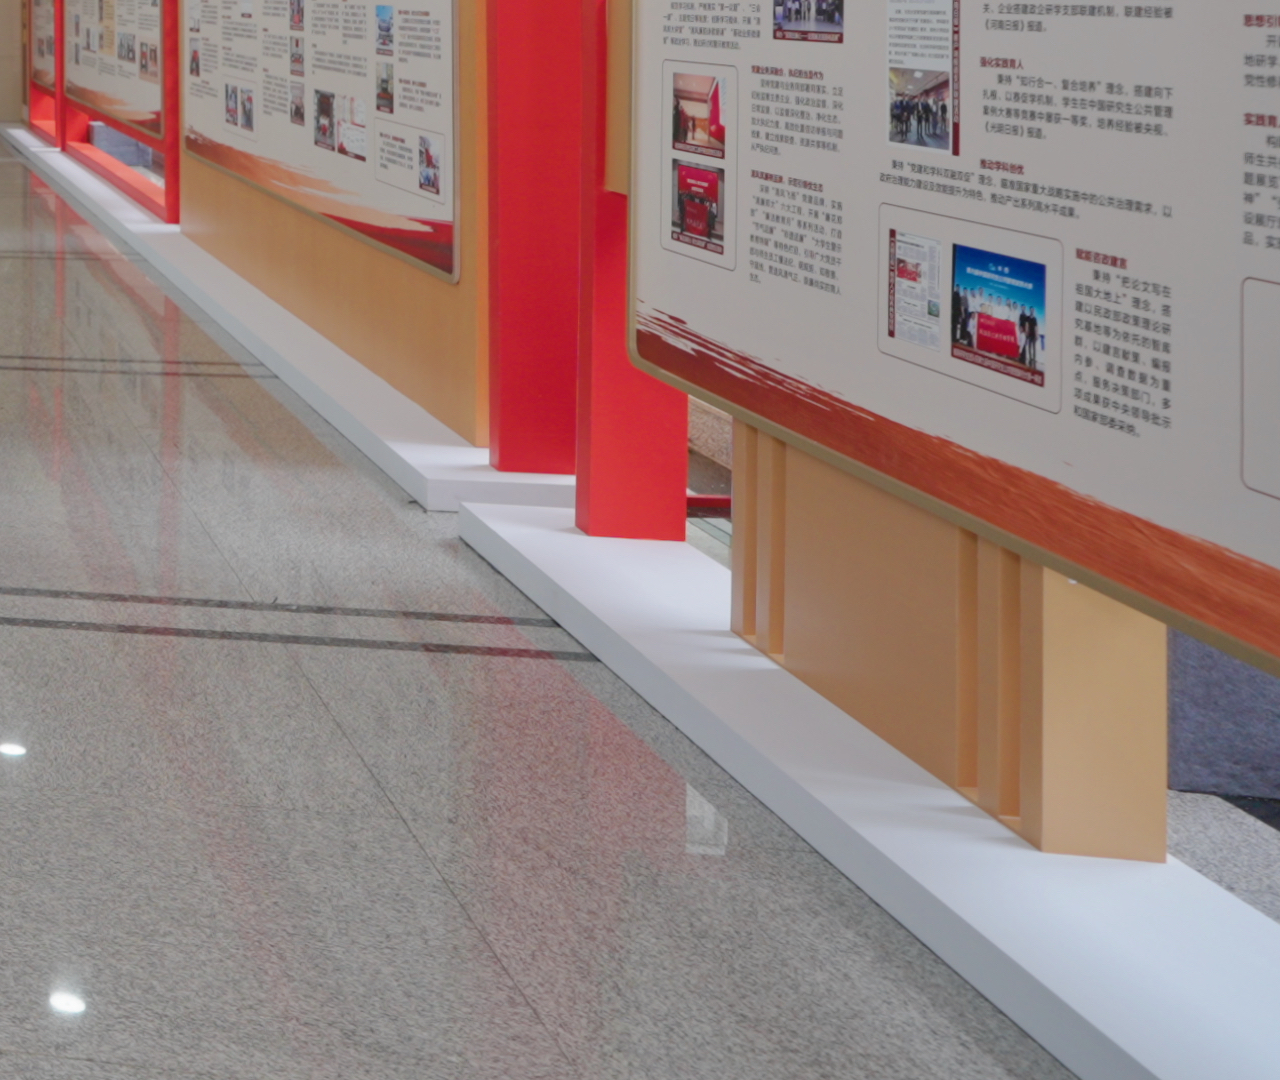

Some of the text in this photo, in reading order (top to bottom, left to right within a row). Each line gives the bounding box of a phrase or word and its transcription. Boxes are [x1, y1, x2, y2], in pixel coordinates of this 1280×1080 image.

[980, 56, 1024, 70] 强化实践育人
